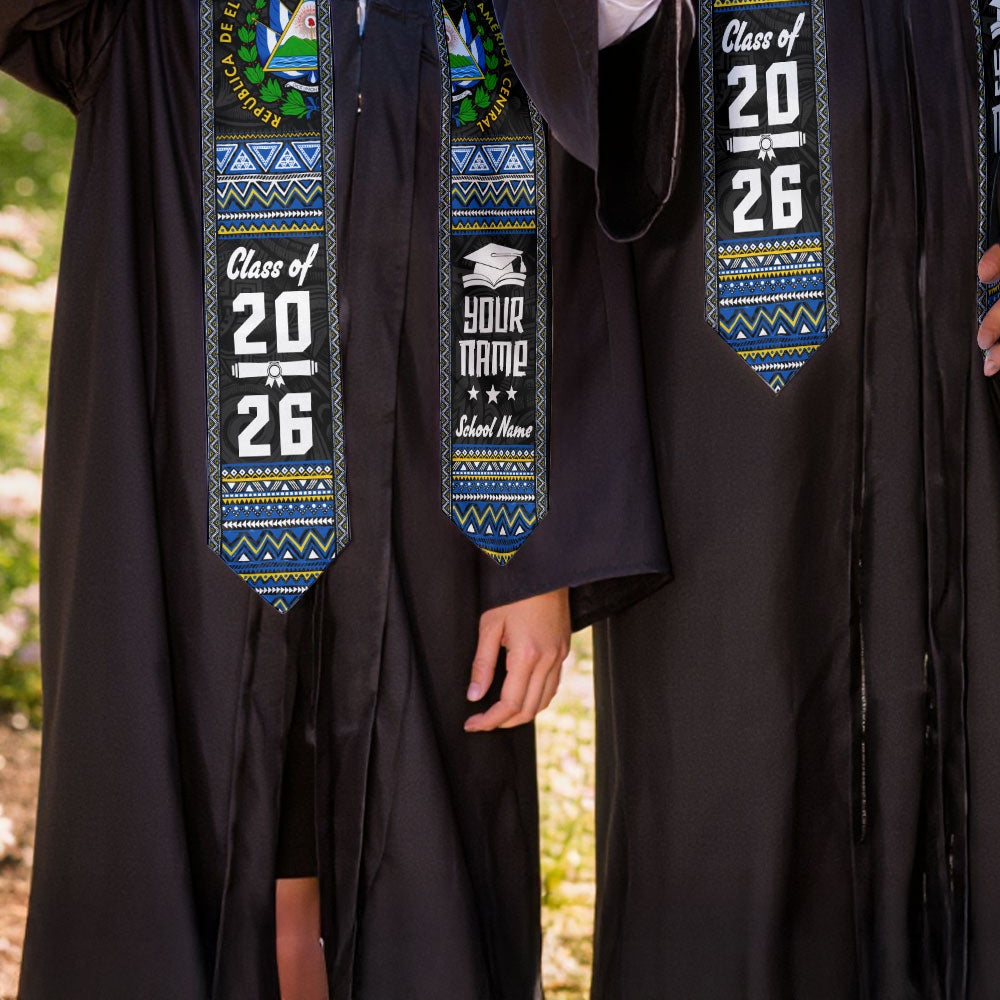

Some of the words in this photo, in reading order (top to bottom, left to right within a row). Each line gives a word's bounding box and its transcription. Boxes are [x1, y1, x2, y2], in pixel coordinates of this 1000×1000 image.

[223, 0, 241, 19] EL
[219, 24, 233, 44] DE
[721, 18, 774, 54] Class
[777, 11, 806, 57] of
[221, 53, 282, 129] REPÚBLICA
[476, 77, 512, 133] CENTRAL
[727, 60, 800, 130] 20
[732, 163, 803, 234] 26
[226, 246, 284, 280] Class
[288, 242, 320, 287] of
[232, 290, 312, 355] 20
[463, 295, 524, 334] YOUR
[458, 339, 528, 378] NAME
[237, 392, 314, 457] 26
[455, 413, 497, 439] School
[496, 414, 533, 439] Name
